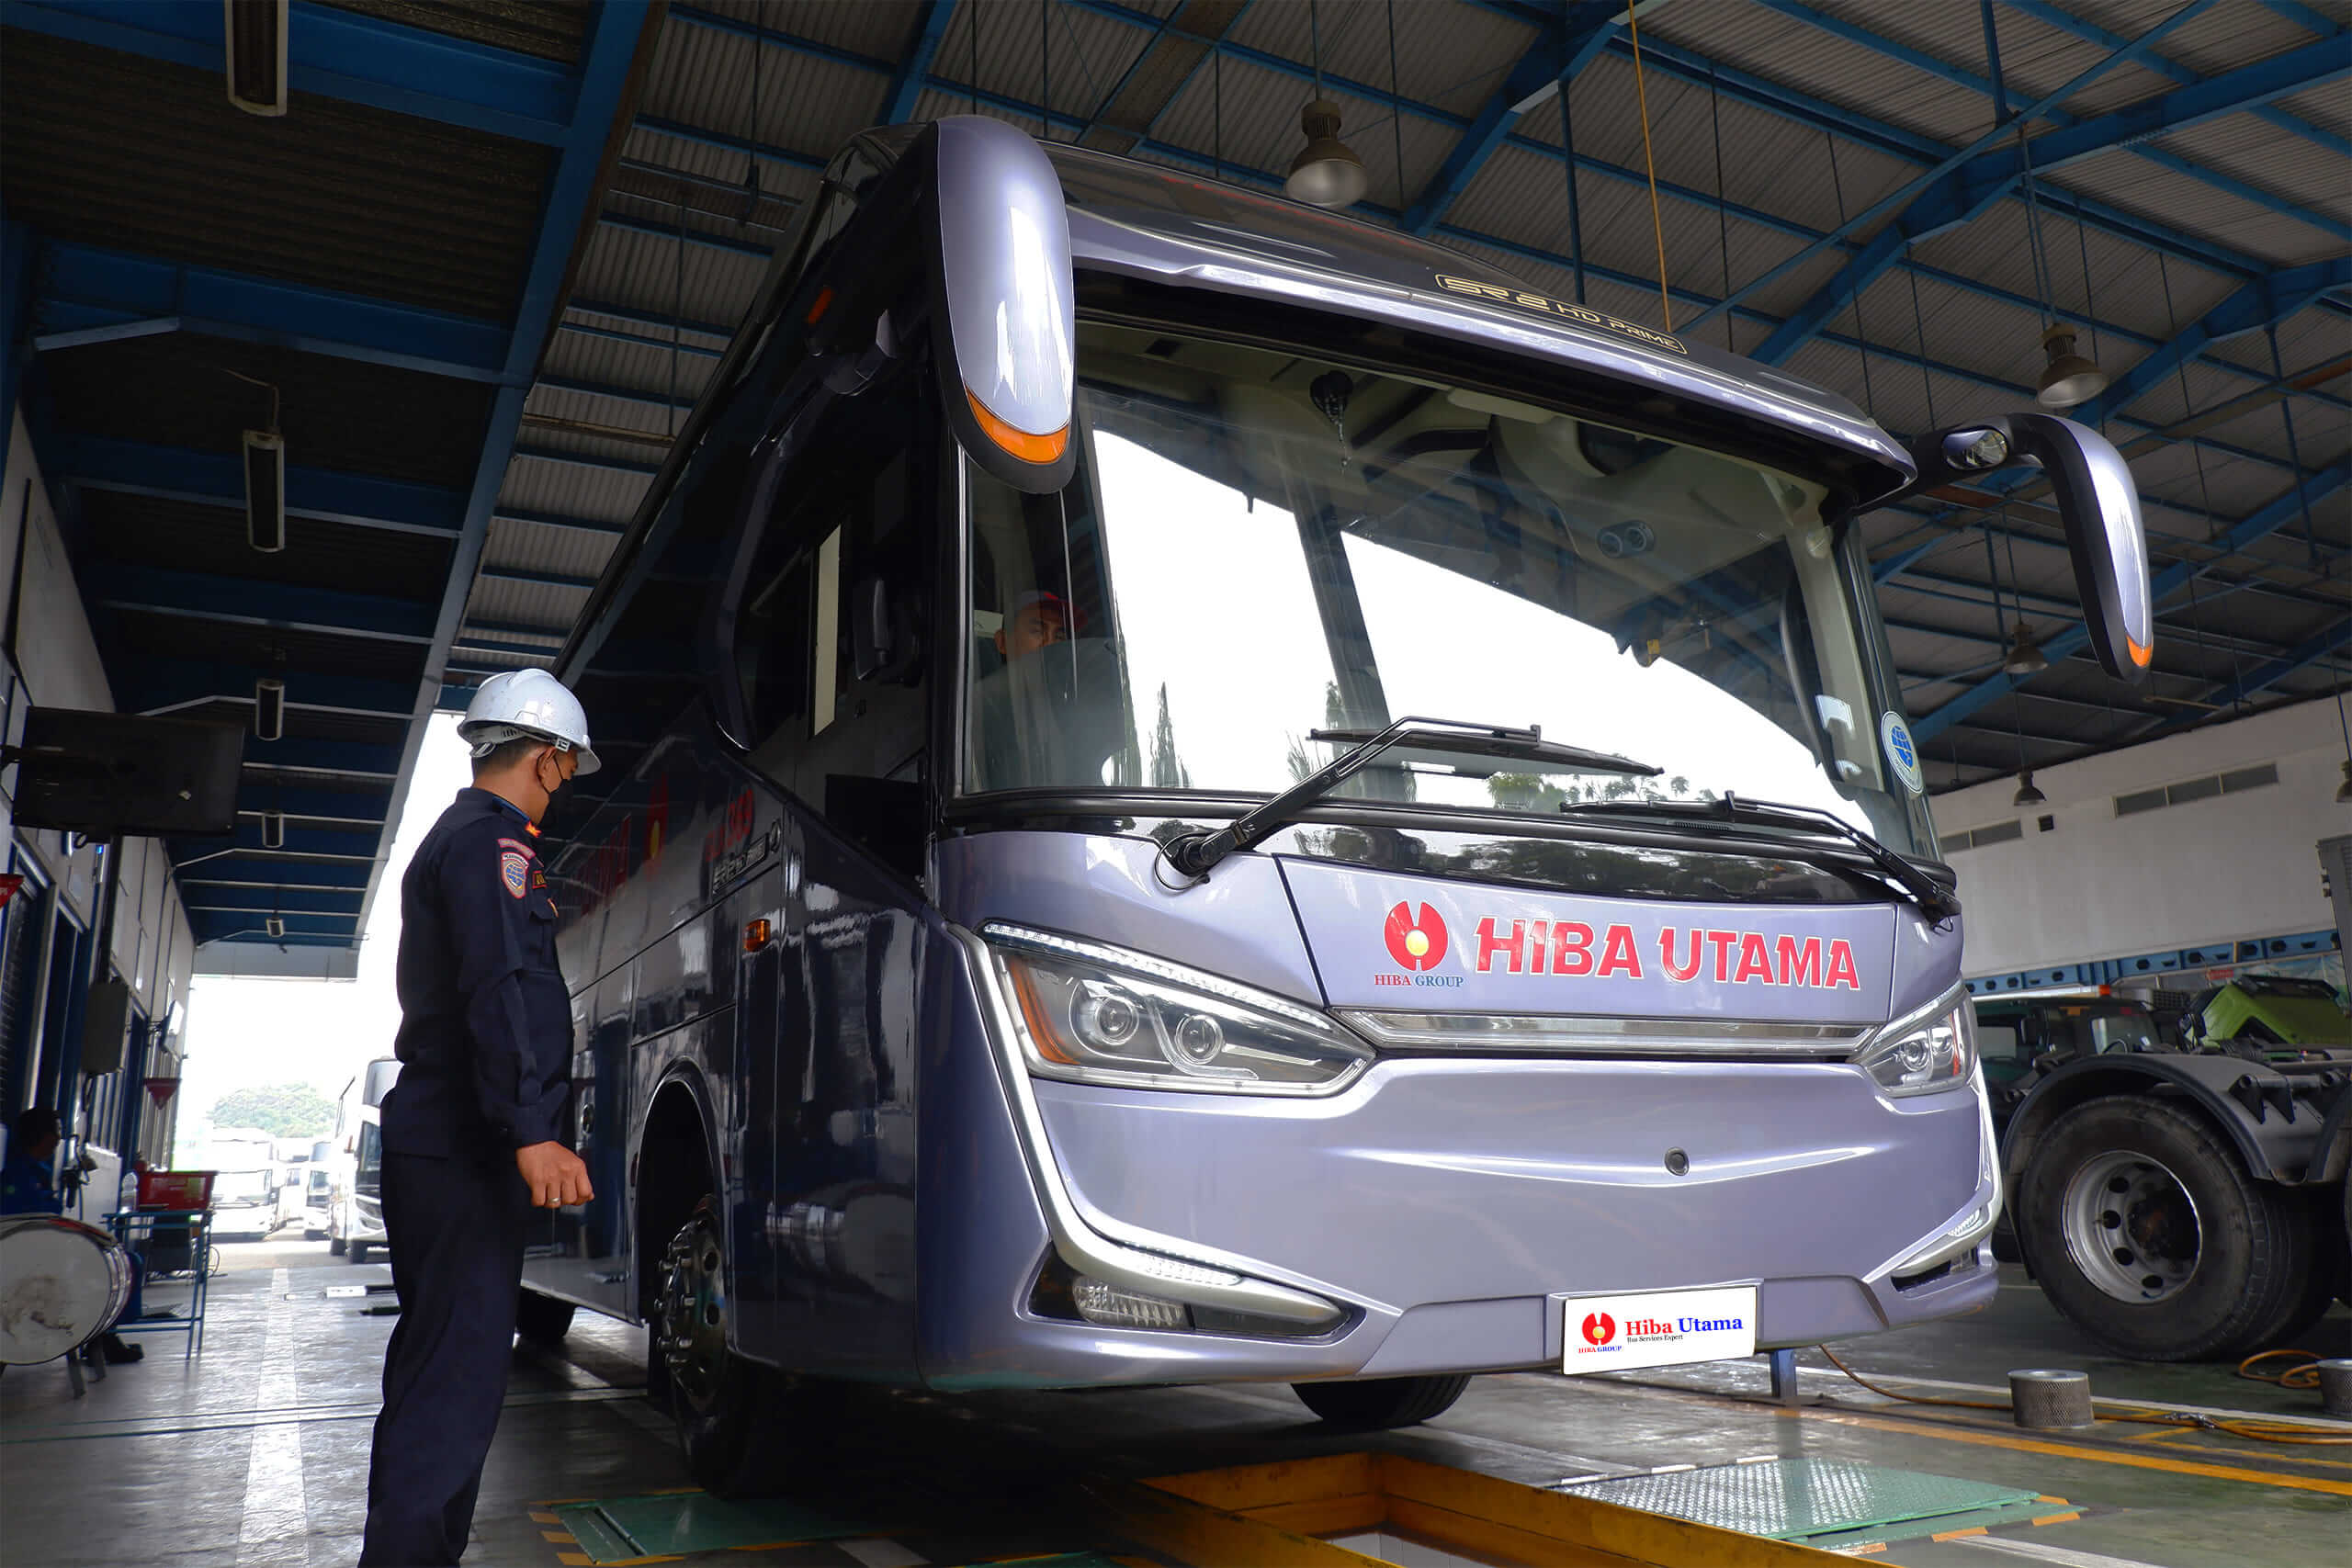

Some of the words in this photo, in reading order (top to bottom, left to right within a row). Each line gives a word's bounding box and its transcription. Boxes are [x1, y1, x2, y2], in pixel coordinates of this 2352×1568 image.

[1444, 278, 1509, 302] SR
[1515, 293, 1551, 310] 2
[1556, 303, 1600, 323] HD
[1607, 318, 1679, 350] PRIME
[1475, 917, 1645, 979] HIBA
[1657, 926, 1860, 991] UTAMA
[1374, 974, 1411, 986] HIBA
[1415, 975, 1464, 987] GROUP
[1624, 1318, 1673, 1336] Hiba
[1677, 1316, 1744, 1333] Utama
[1664, 1334, 1683, 1342] Expert
[1597, 1345, 1623, 1353] GROUP
